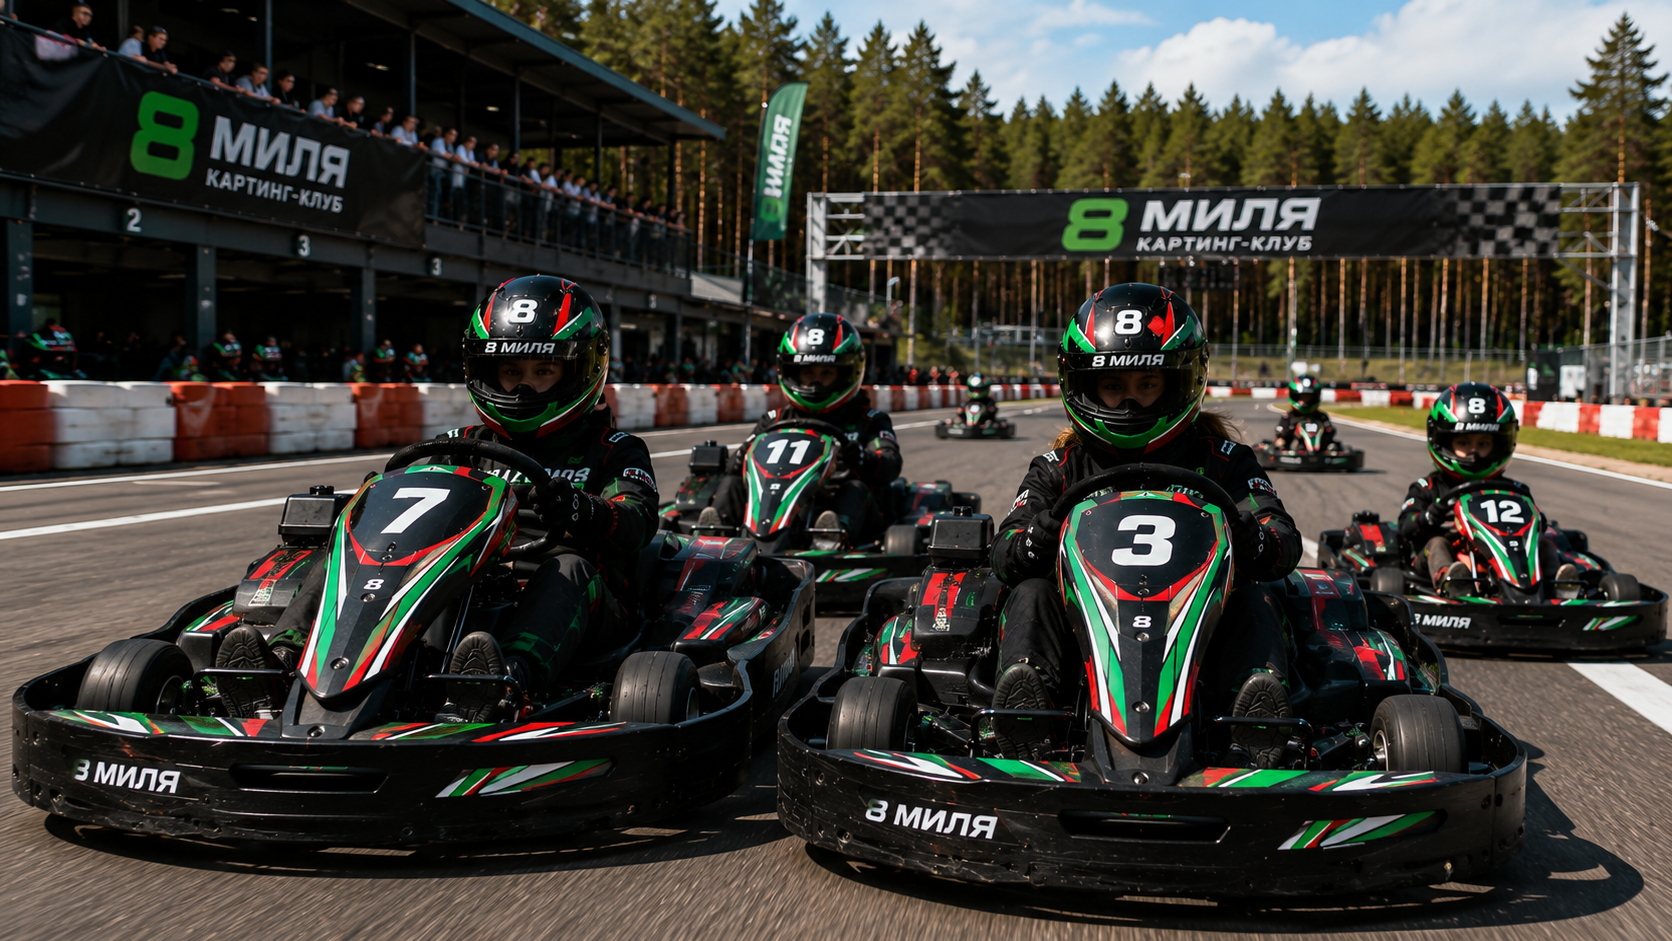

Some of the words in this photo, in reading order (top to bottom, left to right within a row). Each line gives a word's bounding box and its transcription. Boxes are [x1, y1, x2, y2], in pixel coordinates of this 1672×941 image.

[130, 91, 199, 180] 8
[209, 115, 350, 189] МИЛЯ
[205, 168, 344, 214] КАРТИНГ-КЛУБ
[126, 207, 142, 232] 2
[1061, 198, 1129, 251] 8
[1140, 197, 1321, 232] МИЛЯ
[298, 234, 311, 257] 3
[1136, 236, 1313, 252] КАРТИНГ-КЛУБ
[508, 299, 538, 324] 8
[1114, 309, 1143, 335] 8
[485, 342, 498, 353] 8
[500, 342, 556, 354] МИЛЯ
[807, 328, 825, 345] 8
[1092, 355, 1106, 367] 8
[1109, 354, 1165, 367] МИЛЯ
[1468, 397, 1486, 414] 8
[766, 438, 811, 465] 11
[380, 487, 451, 535] 7
[1480, 499, 1525, 524] 12
[1111, 514, 1177, 567] 3
[363, 578, 385, 590] 8
[1132, 615, 1152, 628] 8
[1422, 614, 1472, 629] МИЛЯ
[93, 761, 181, 794] МИЛЯ
[864, 798, 889, 823] 8
[893, 803, 998, 840] МИЛЯ
